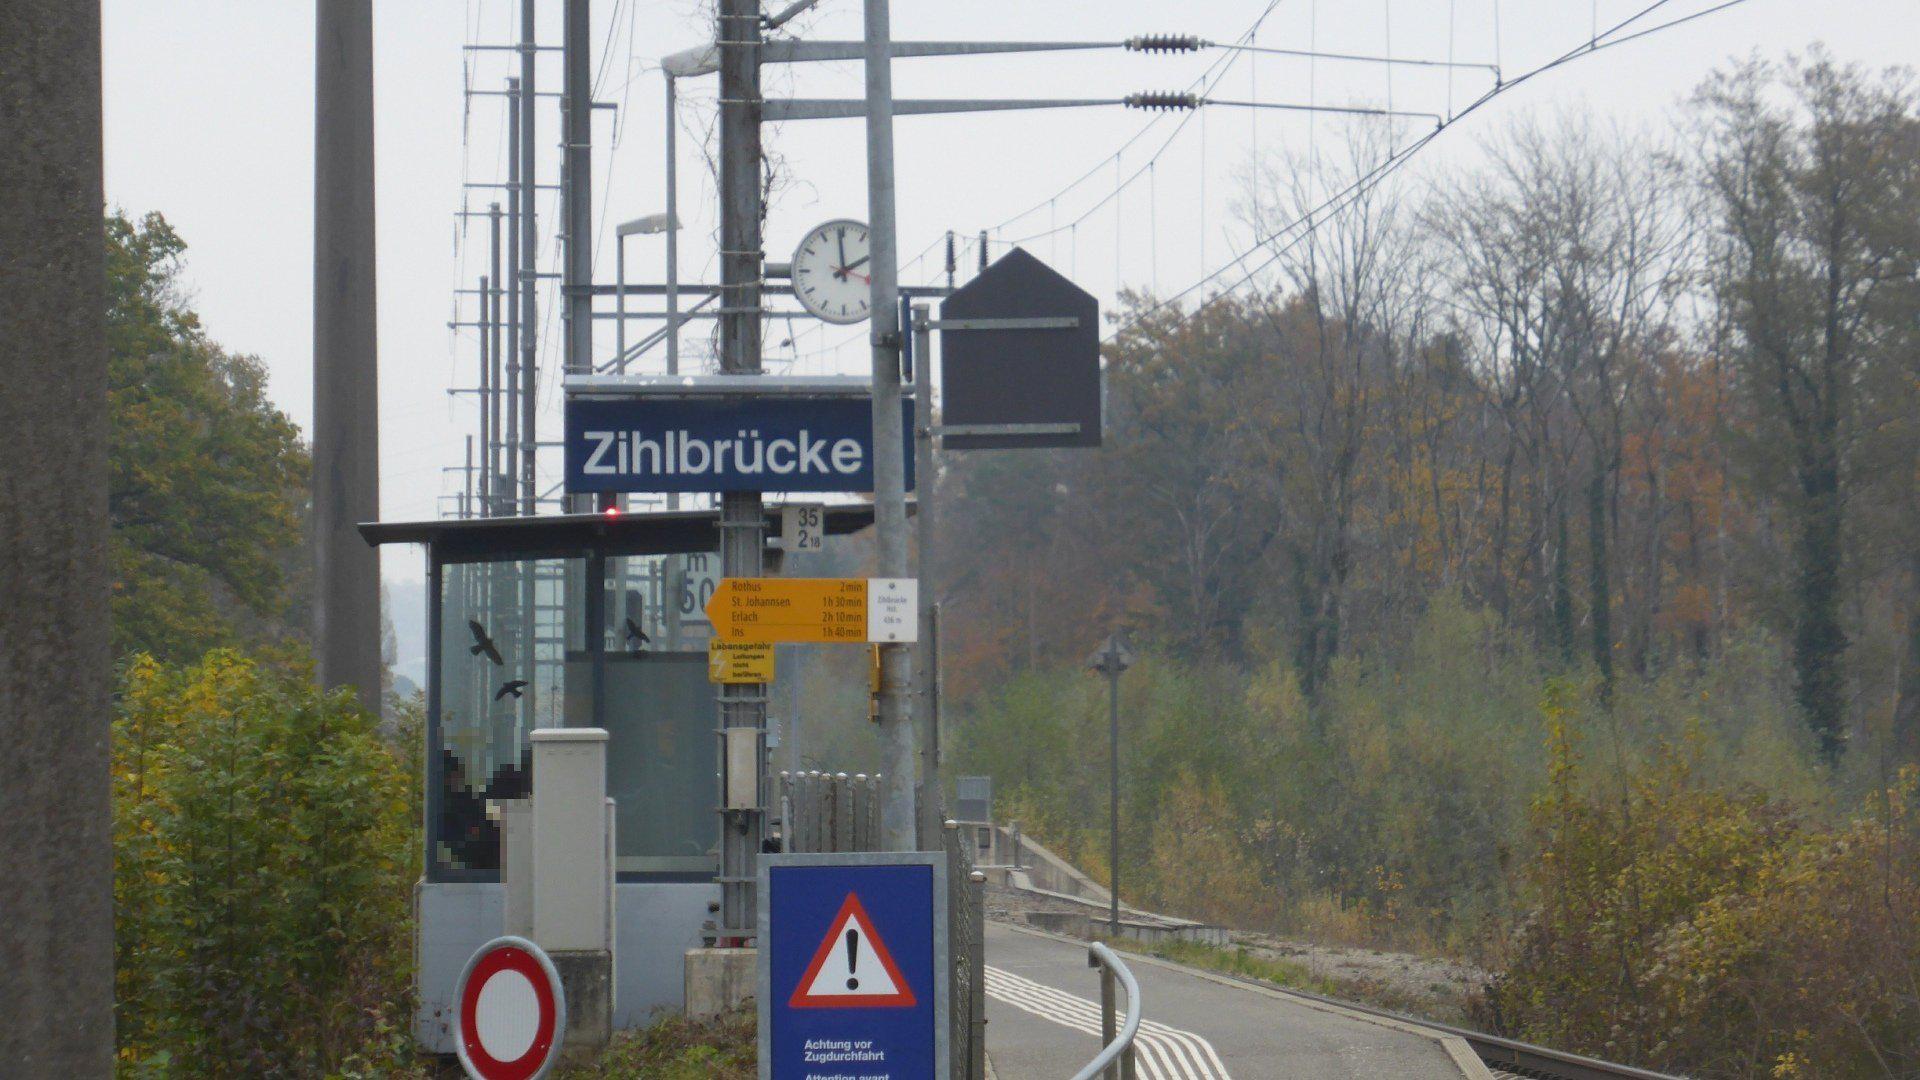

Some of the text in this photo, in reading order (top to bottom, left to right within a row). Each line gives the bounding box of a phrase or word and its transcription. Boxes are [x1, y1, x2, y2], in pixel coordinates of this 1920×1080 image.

[583, 429, 863, 475] Zihlbrücke
[798, 507, 818, 527] 35
[732, 581, 761, 592] Rothus
[732, 597, 744, 607] St.
[746, 597, 791, 607] Johannsen
[732, 612, 758, 622] Erlach
[732, 627, 744, 637] Ins
[711, 641, 771, 651] Lebensgefahr
[804, 1039, 873, 1051] Achtung vor
[804, 1050, 885, 1064] Zugdurchfahrt
